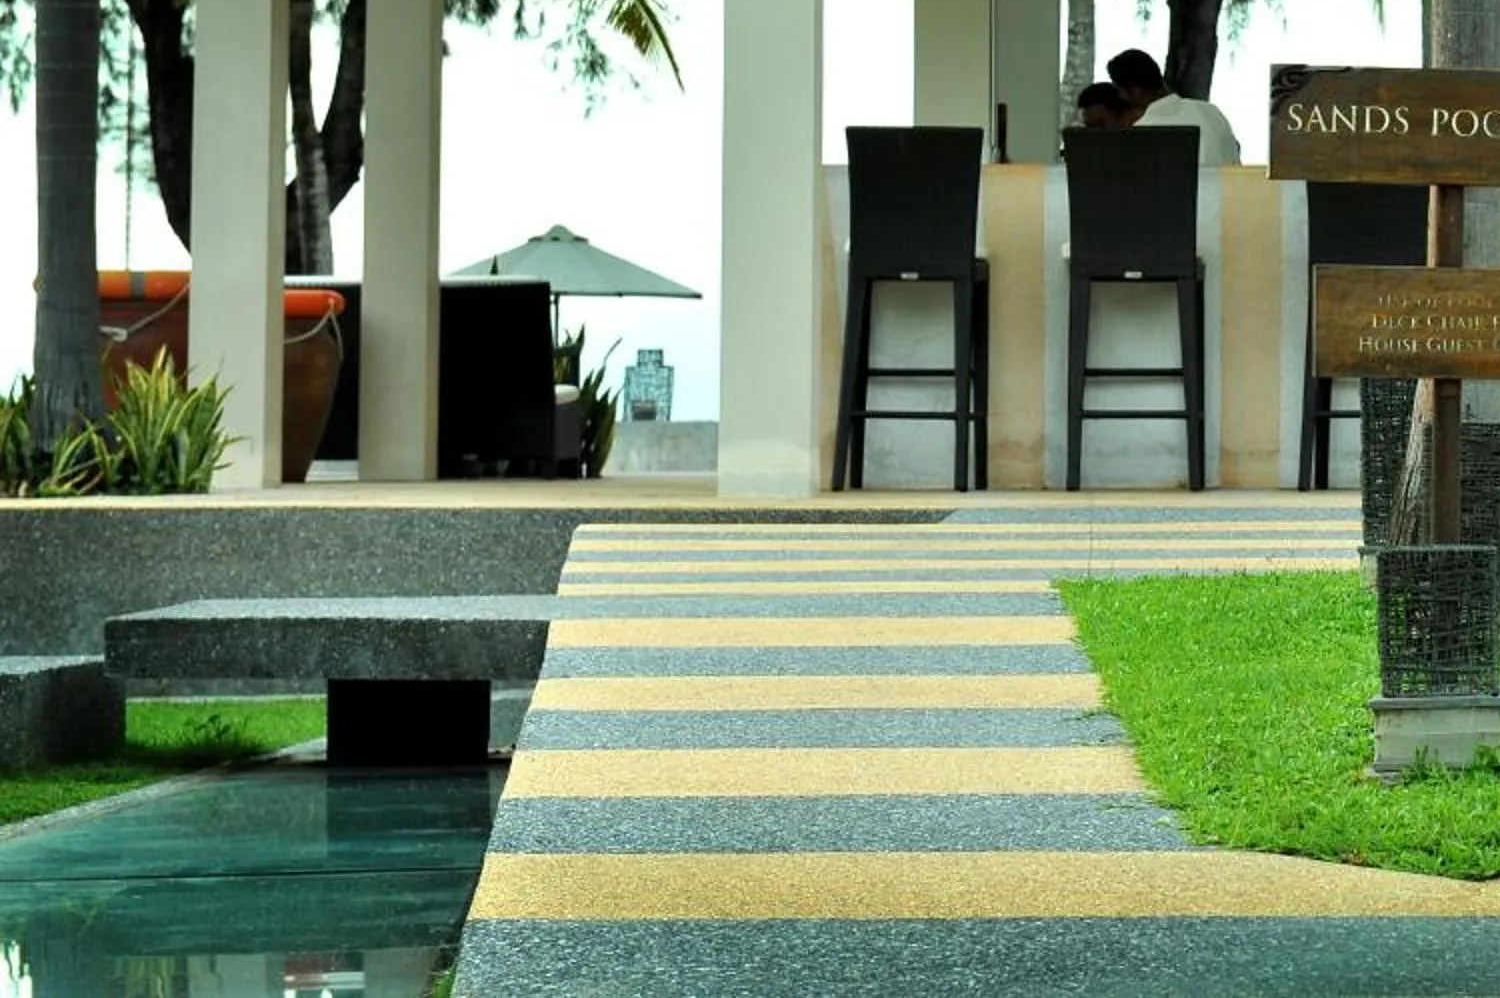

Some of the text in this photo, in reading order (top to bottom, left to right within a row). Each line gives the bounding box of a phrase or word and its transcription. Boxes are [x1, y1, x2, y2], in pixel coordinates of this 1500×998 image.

[1287, 103, 1410, 133] SANDS
[1371, 313, 1418, 330] DECK
[1358, 337, 1419, 354] HOUSE
[1426, 337, 1489, 353] GUEST
